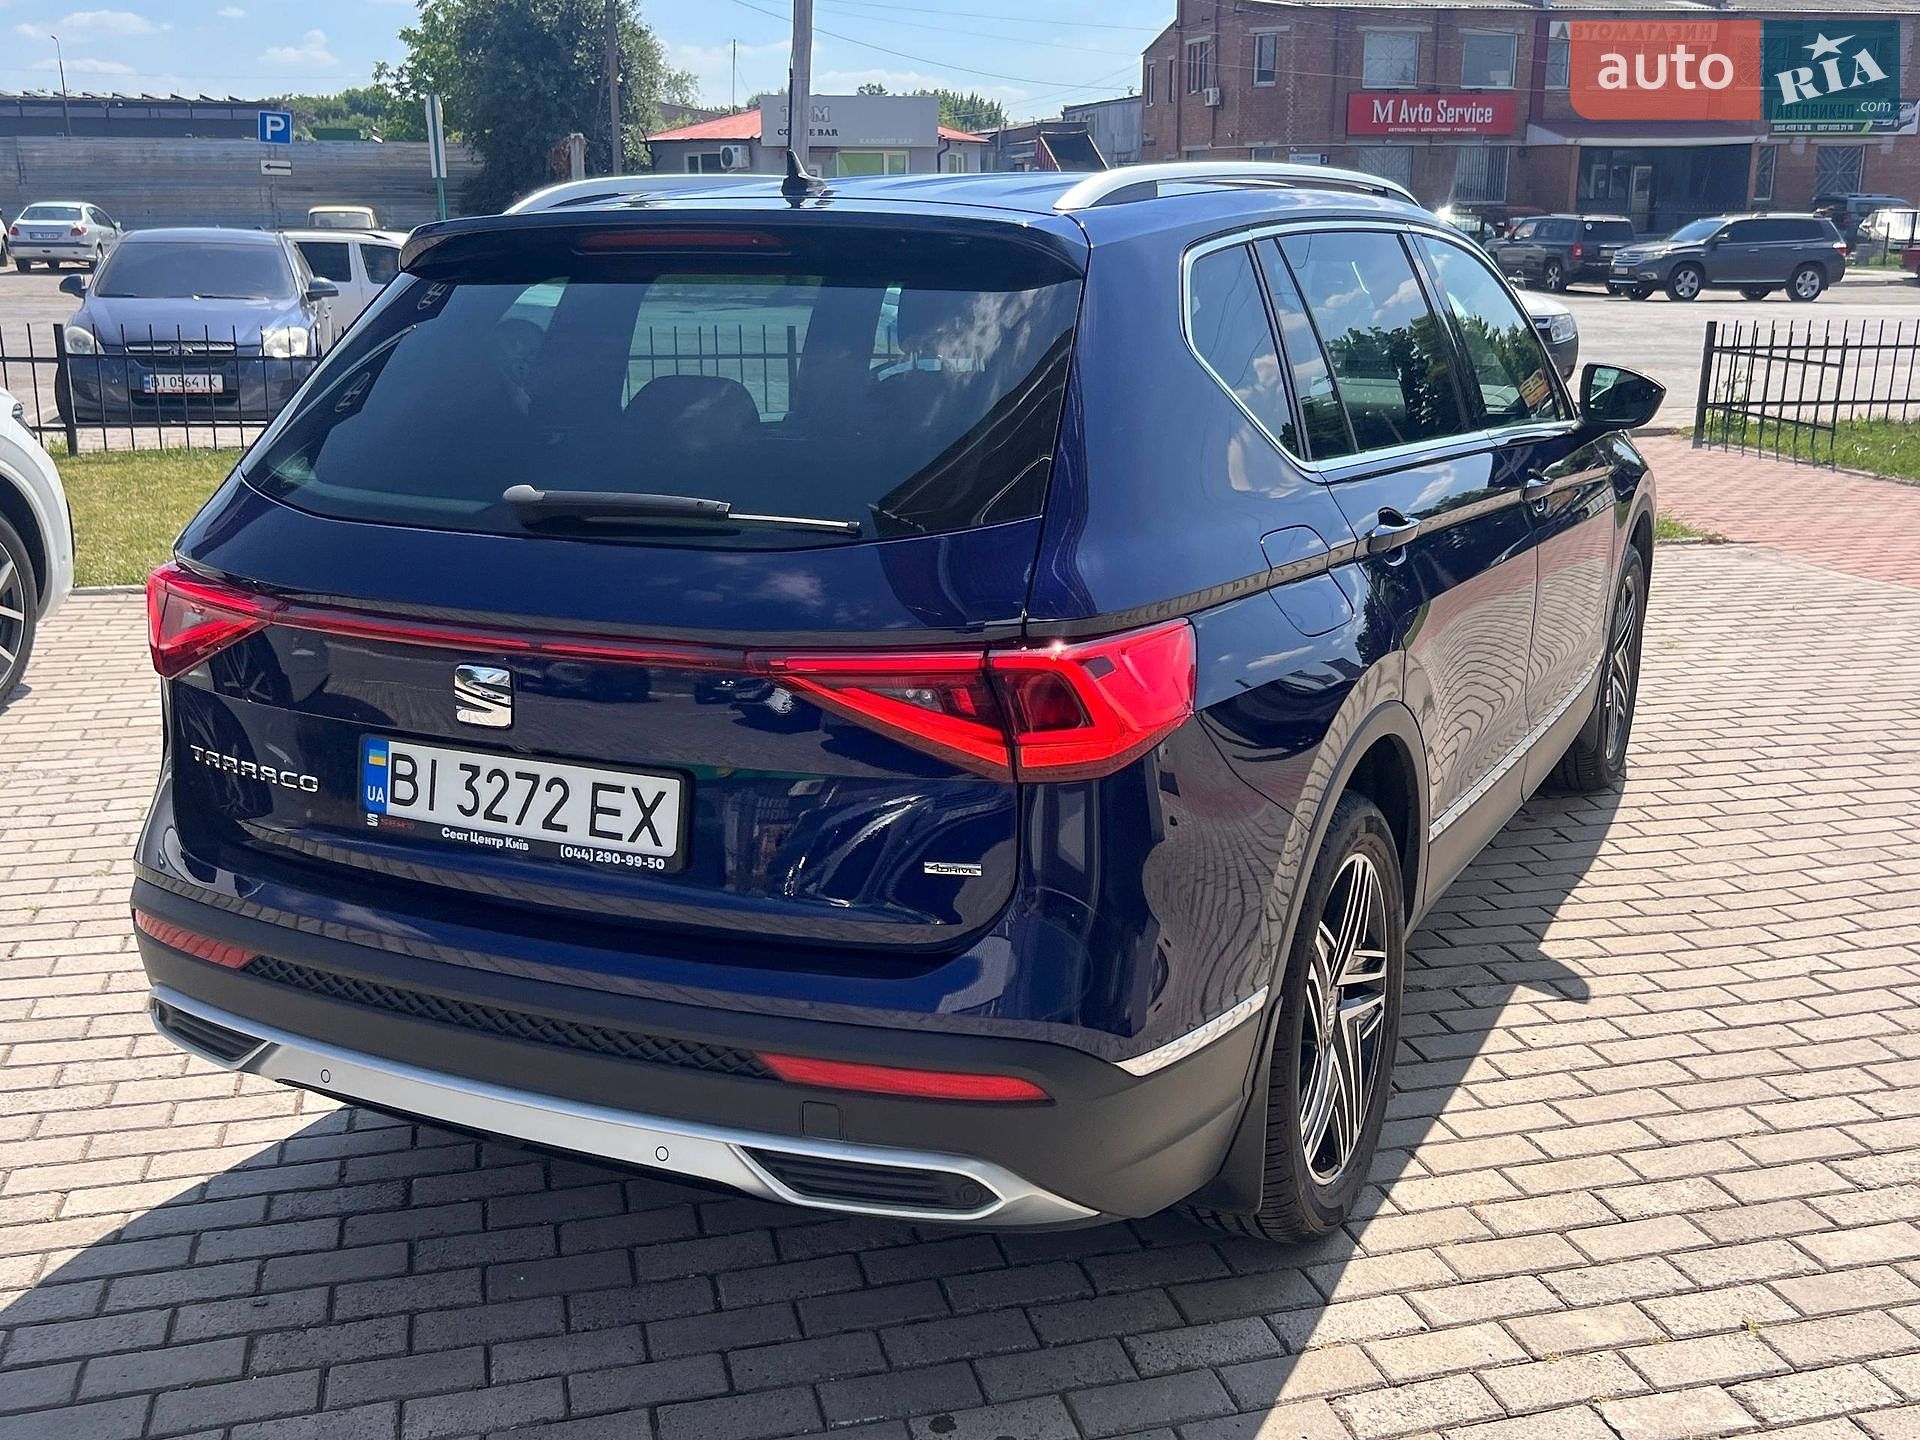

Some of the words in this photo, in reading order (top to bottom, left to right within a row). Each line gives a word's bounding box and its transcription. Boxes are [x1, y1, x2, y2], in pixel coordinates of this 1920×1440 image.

[780, 105, 831, 123] TM
[1371, 99, 1395, 124] M
[1398, 99, 1432, 124] Avto
[1436, 99, 1493, 124] Service
[266, 115, 286, 140] P
[817, 128, 839, 137] BAR
[190, 744, 319, 793] TARRACO
[366, 785, 386, 804] UA
[389, 751, 438, 811] BI
[456, 762, 571, 834] 3272
[588, 781, 668, 848] EX
[441, 826, 469, 840] Сеат
[469, 831, 504, 849] Центр
[505, 838, 530, 851] Київ
[560, 843, 594, 862] (044)
[595, 850, 666, 870] 290-99-50
